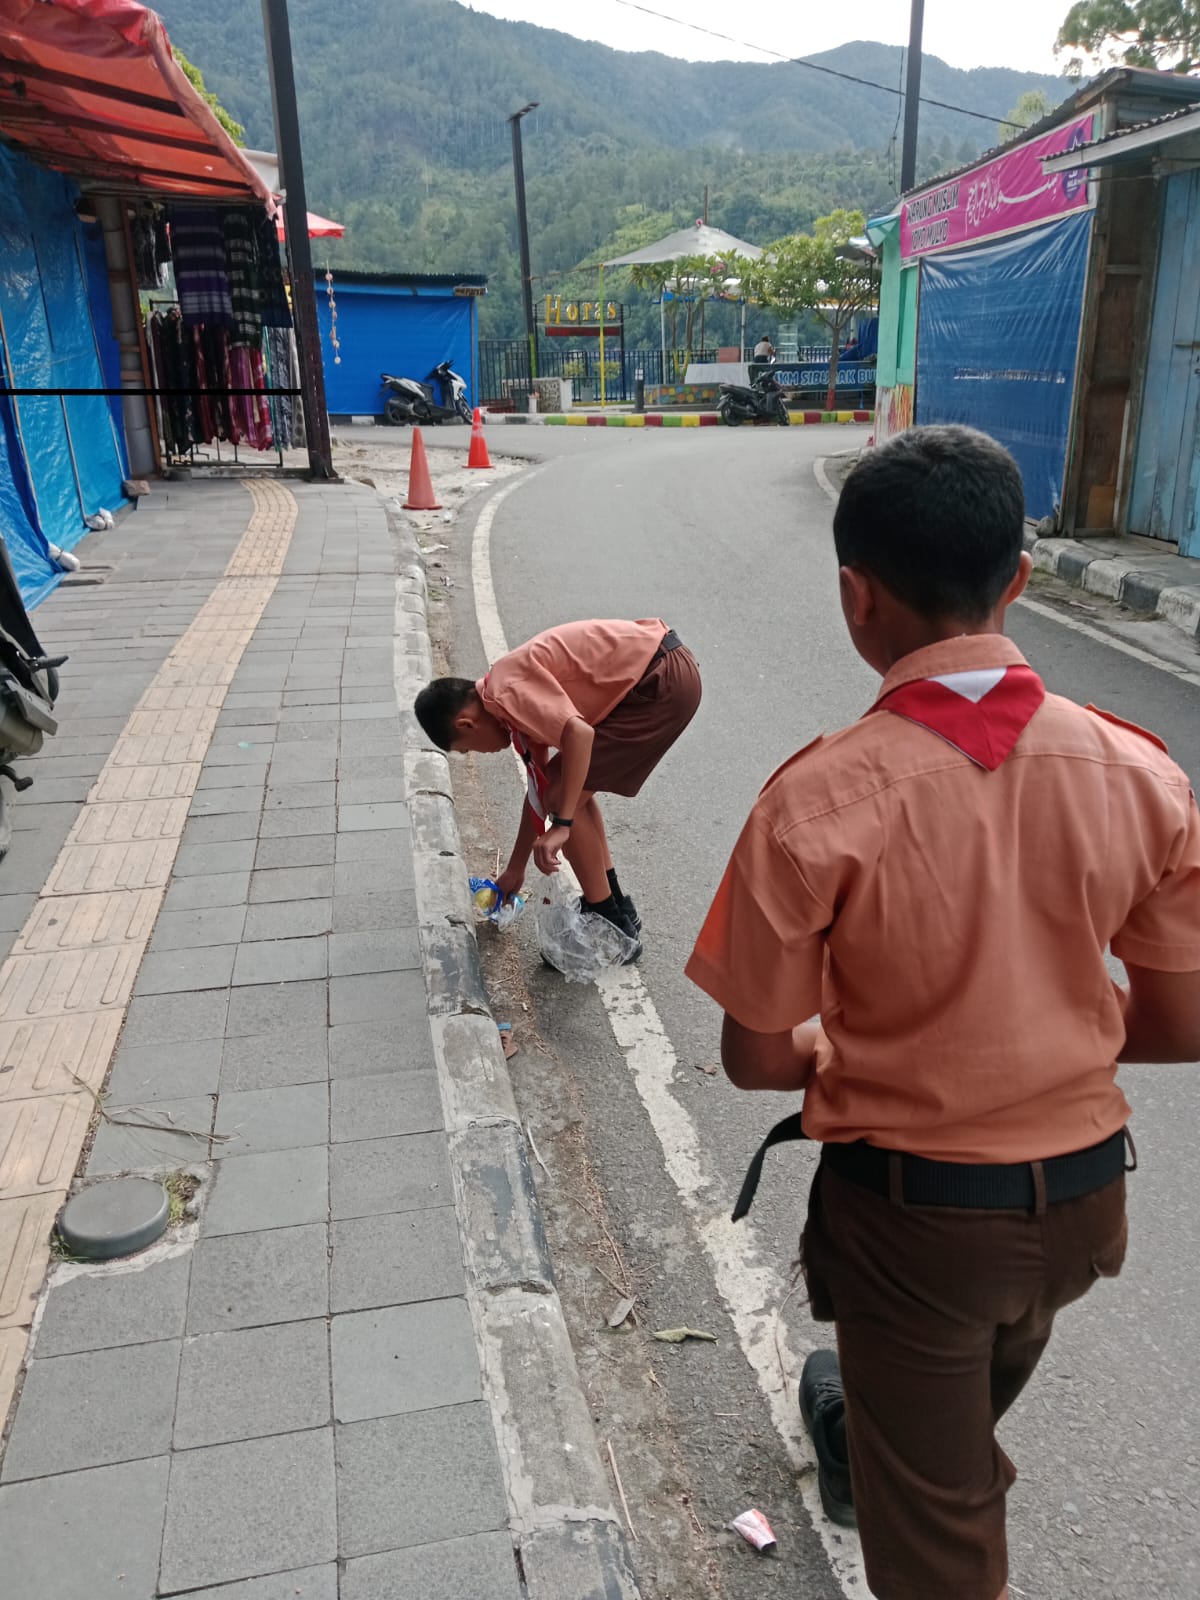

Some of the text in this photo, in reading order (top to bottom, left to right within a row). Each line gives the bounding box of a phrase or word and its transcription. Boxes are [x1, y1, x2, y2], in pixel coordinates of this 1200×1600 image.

[933, 182, 960, 214] MUSLIM
[544, 294, 617, 325] Horas
[800, 369, 856, 385] SIBUAK
